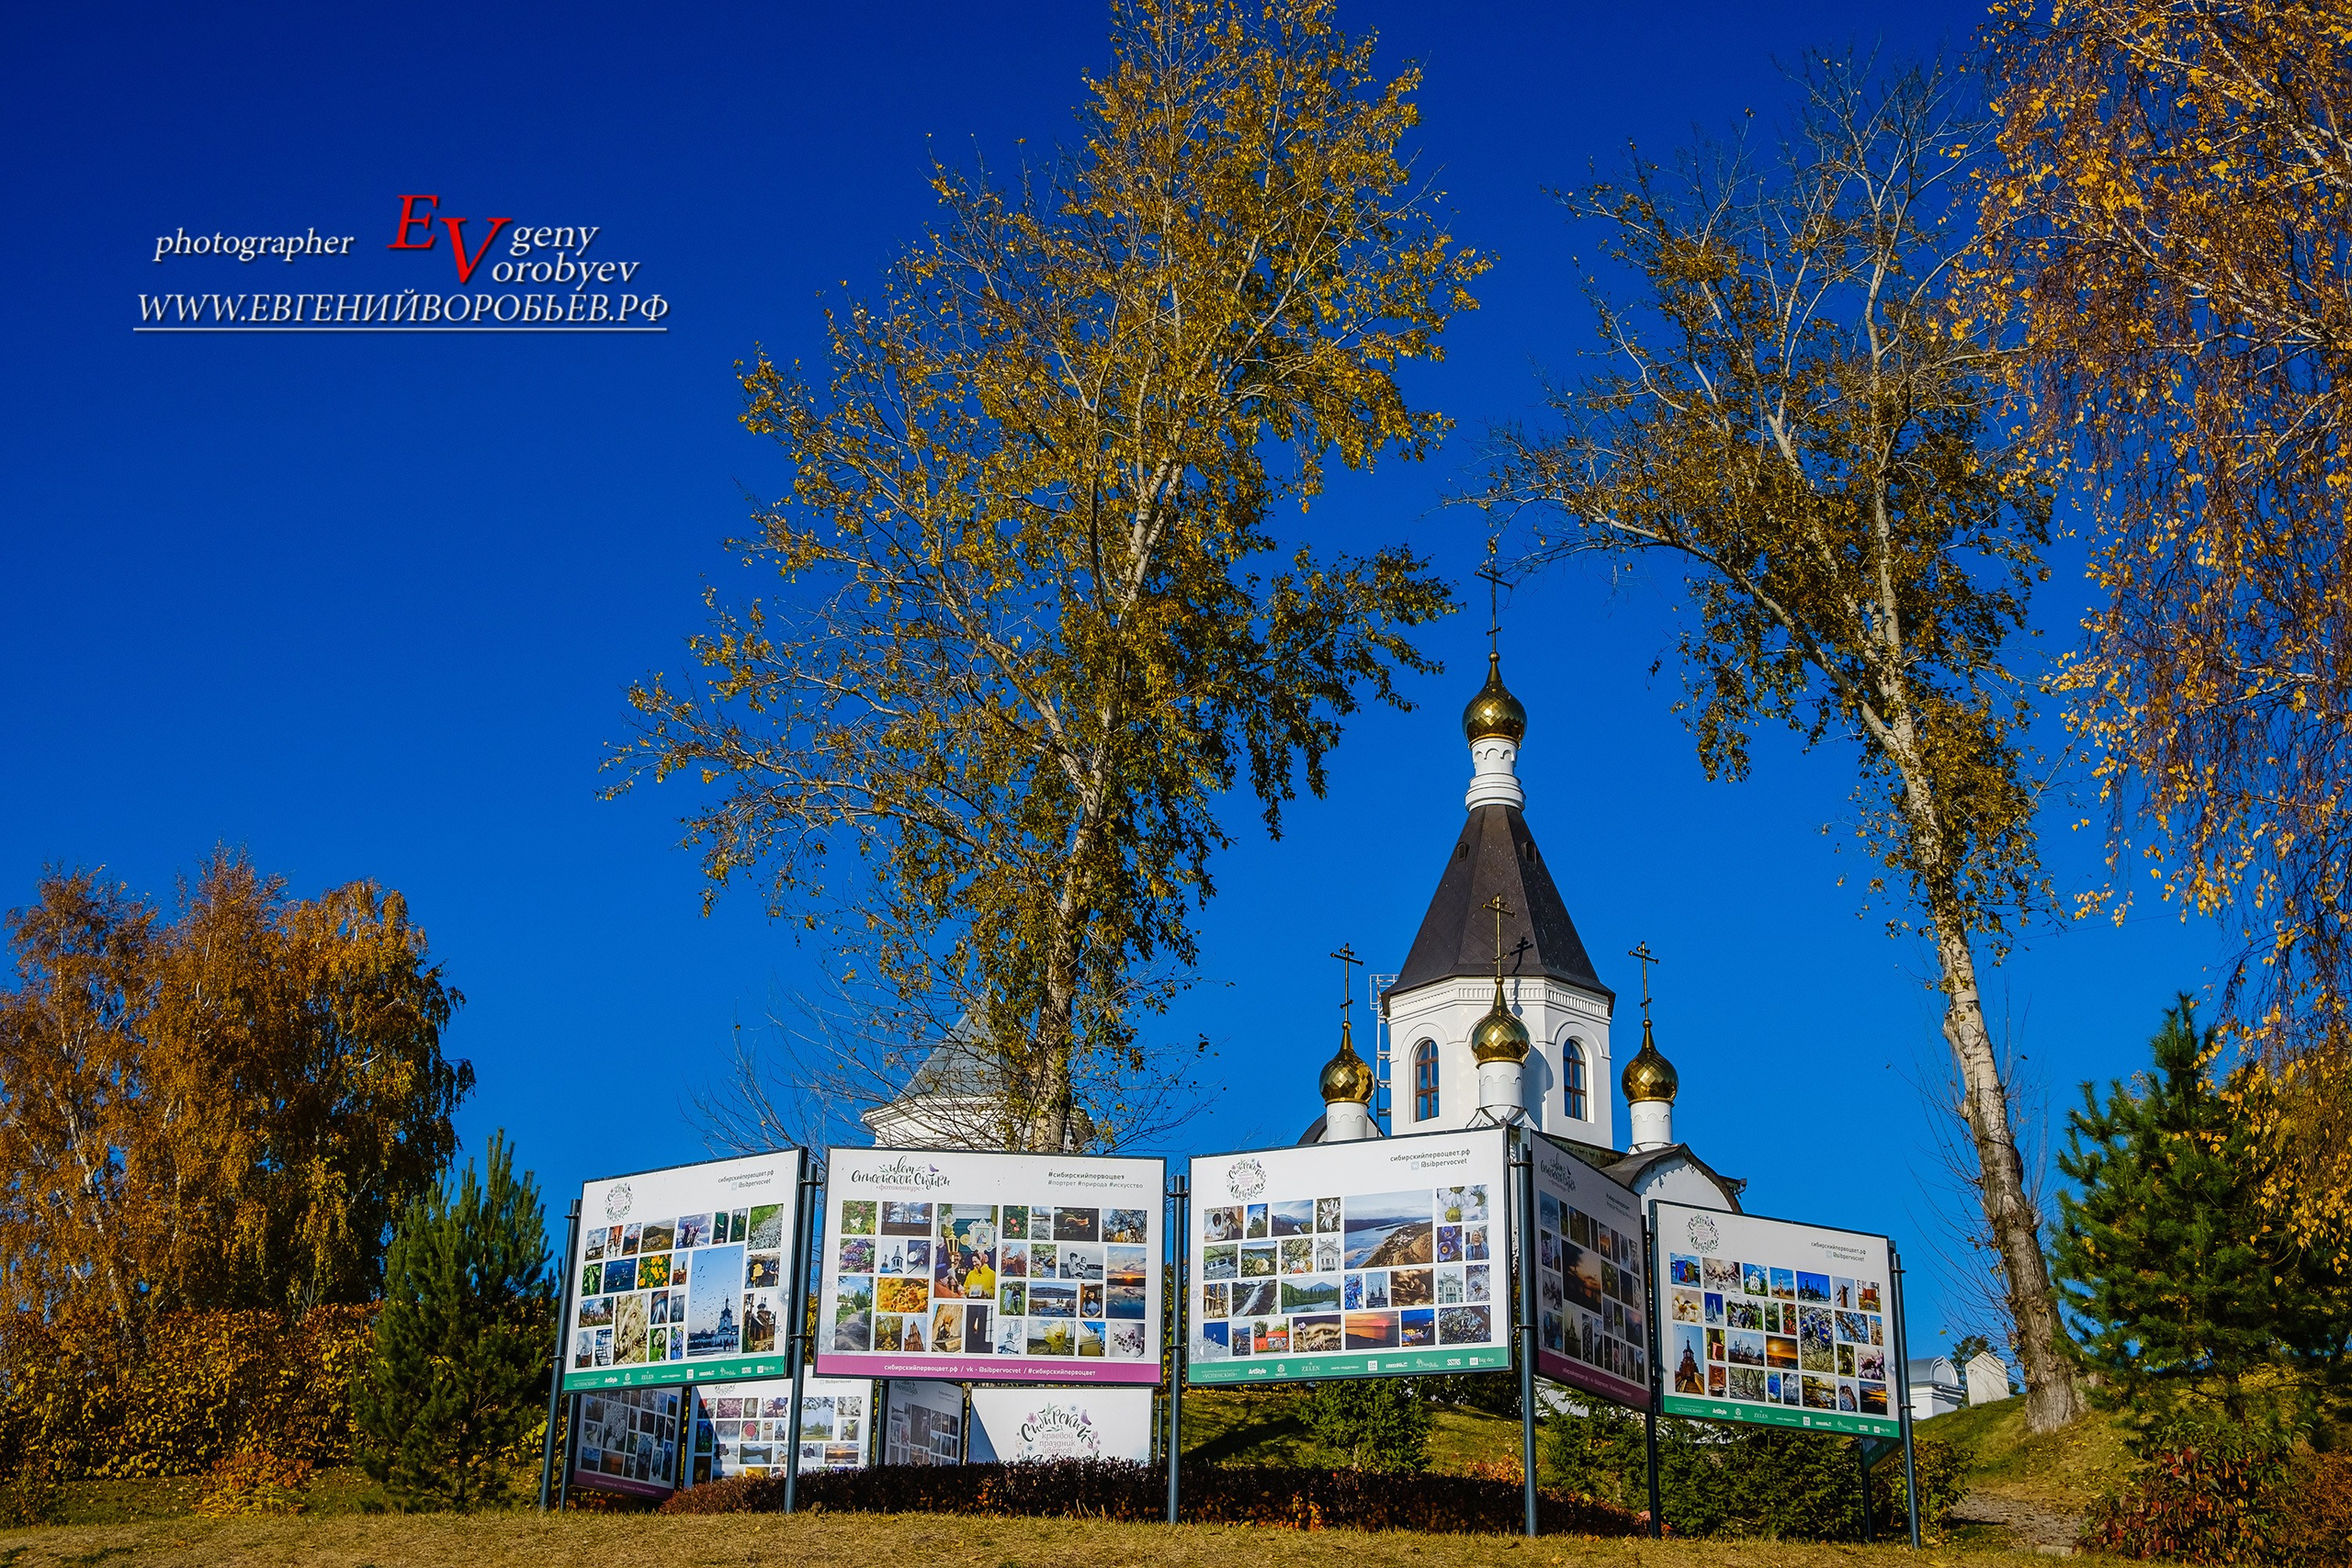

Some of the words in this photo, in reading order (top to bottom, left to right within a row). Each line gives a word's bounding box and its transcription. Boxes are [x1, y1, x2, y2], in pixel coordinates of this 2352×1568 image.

[1389, 1148, 1471, 1162] сибирскийпервоцвет.рф
[1420, 1157, 1467, 1168] @sibpervocvet
[878, 1183, 921, 1192] фотоконкурс
[1077, 1180, 1108, 1189] #природа
[1108, 1181, 1144, 1190] #искусство
[884, 1364, 958, 1373] сибирскийпервоцвет.рф
[978, 1365, 1022, 1374] @sibpervocvet
[1027, 1367, 1096, 1376] #сибирскийпервоцвет
[1021, 1408, 1092, 1443] Сибирский
[1041, 1431, 1074, 1440] краевой
[1038, 1438, 1076, 1448] праздник
